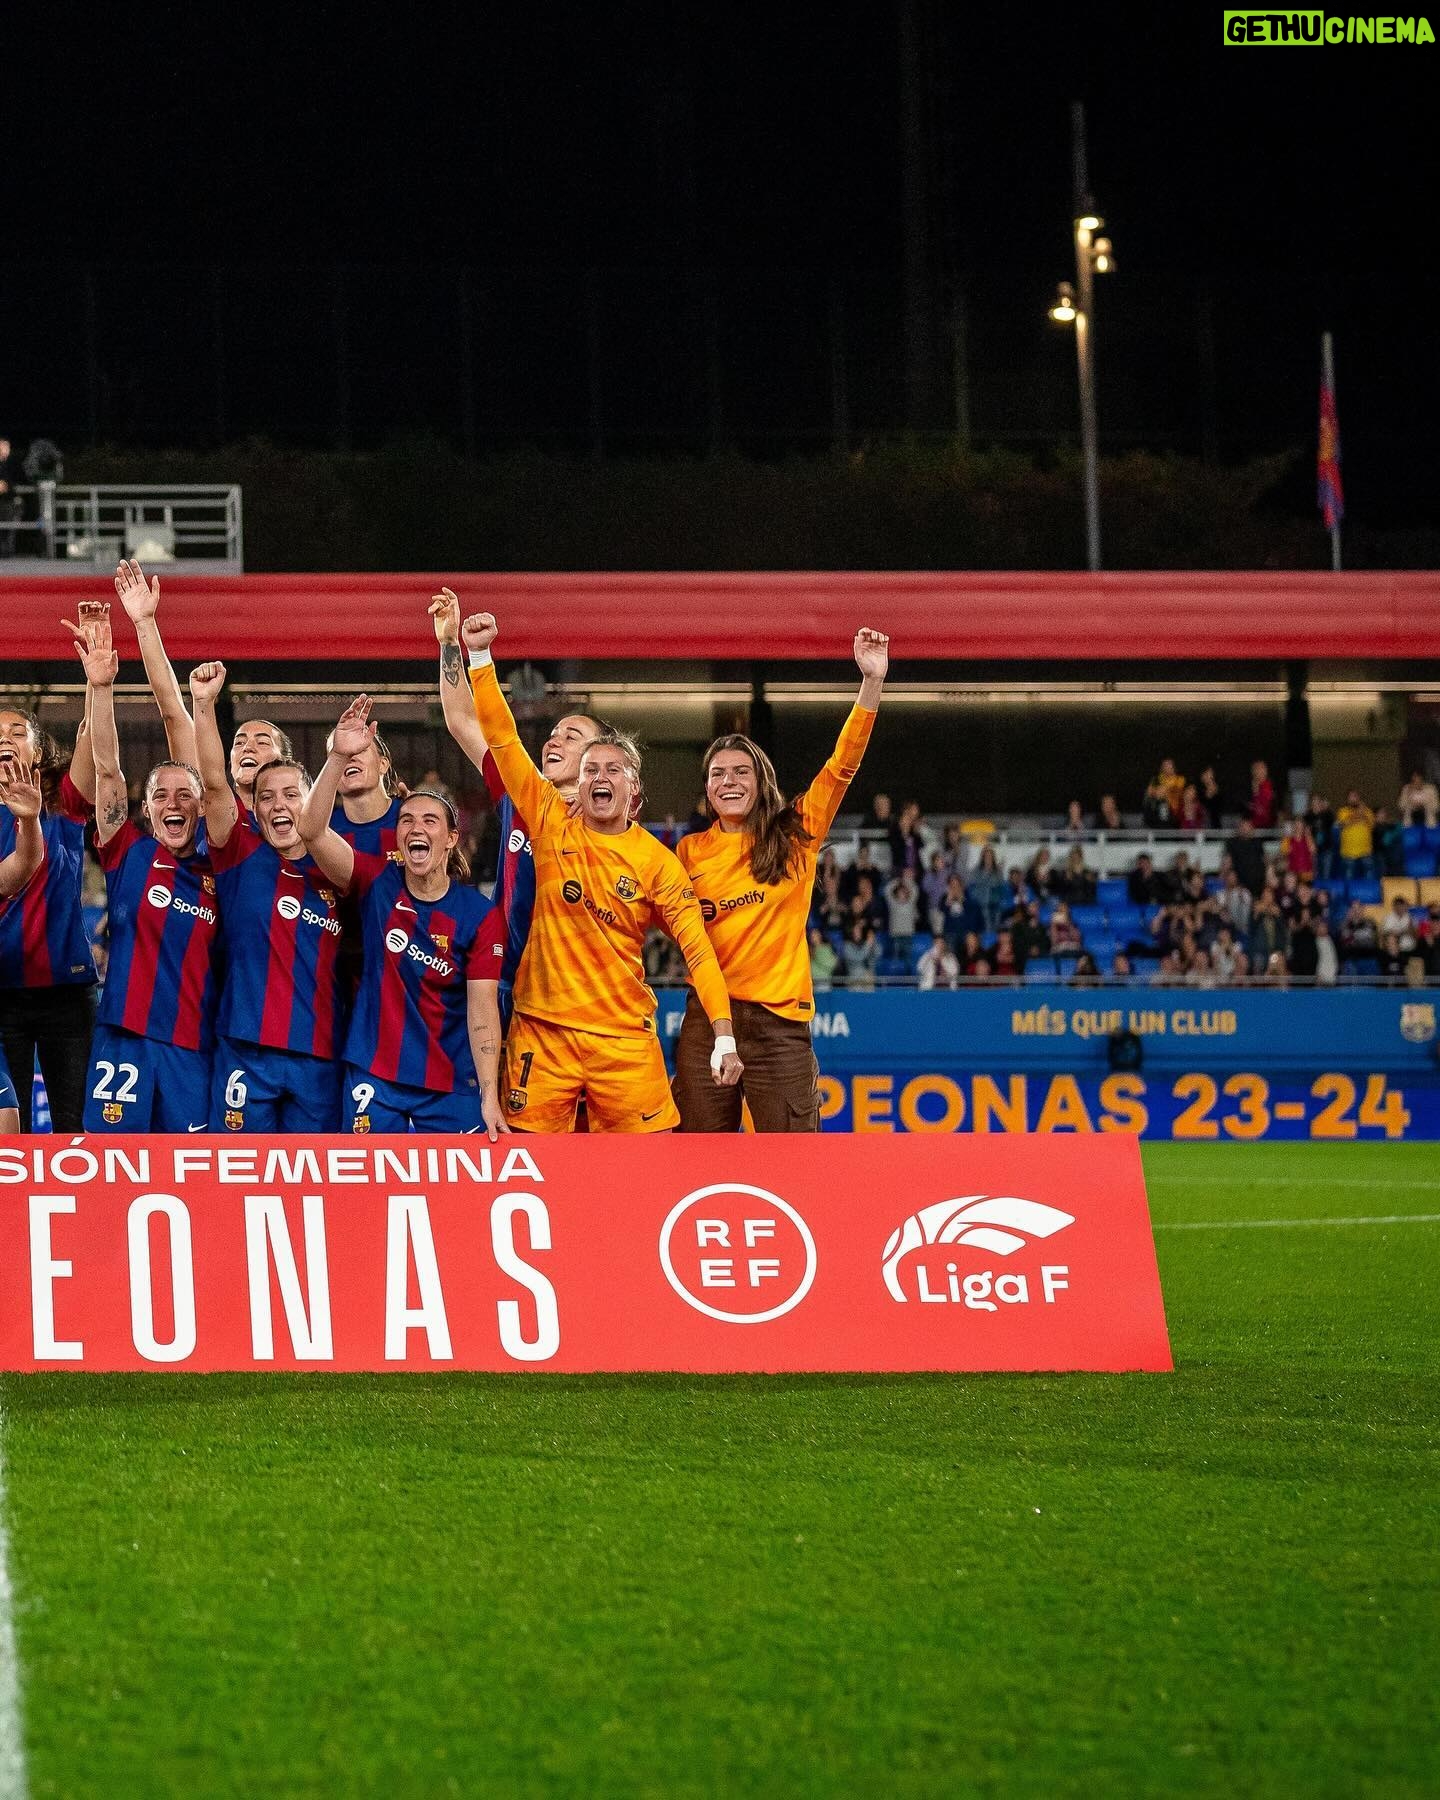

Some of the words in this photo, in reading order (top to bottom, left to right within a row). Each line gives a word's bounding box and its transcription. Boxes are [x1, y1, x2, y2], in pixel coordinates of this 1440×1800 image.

[172, 897, 216, 925] Spotify
[719, 890, 765, 911] Spotify
[301, 908, 342, 936] Spotify
[407, 943, 453, 977] Spotify
[1012, 1004, 1066, 1035] MÉS
[1129, 1010, 1166, 1034] UN
[1171, 1010, 1237, 1035] CLUB
[93, 1060, 139, 1102] 22
[520, 1052, 534, 1088] 1
[225, 1069, 247, 1108] 6
[352, 1083, 375, 1113] 9
[1172, 1072, 1411, 1139] 23-24
[174, 1148, 545, 1184] FEMENINA
[28, 1192, 560, 1363] EONAS
[917, 1263, 1029, 1312] Liga
[1041, 1265, 1069, 1303] F
